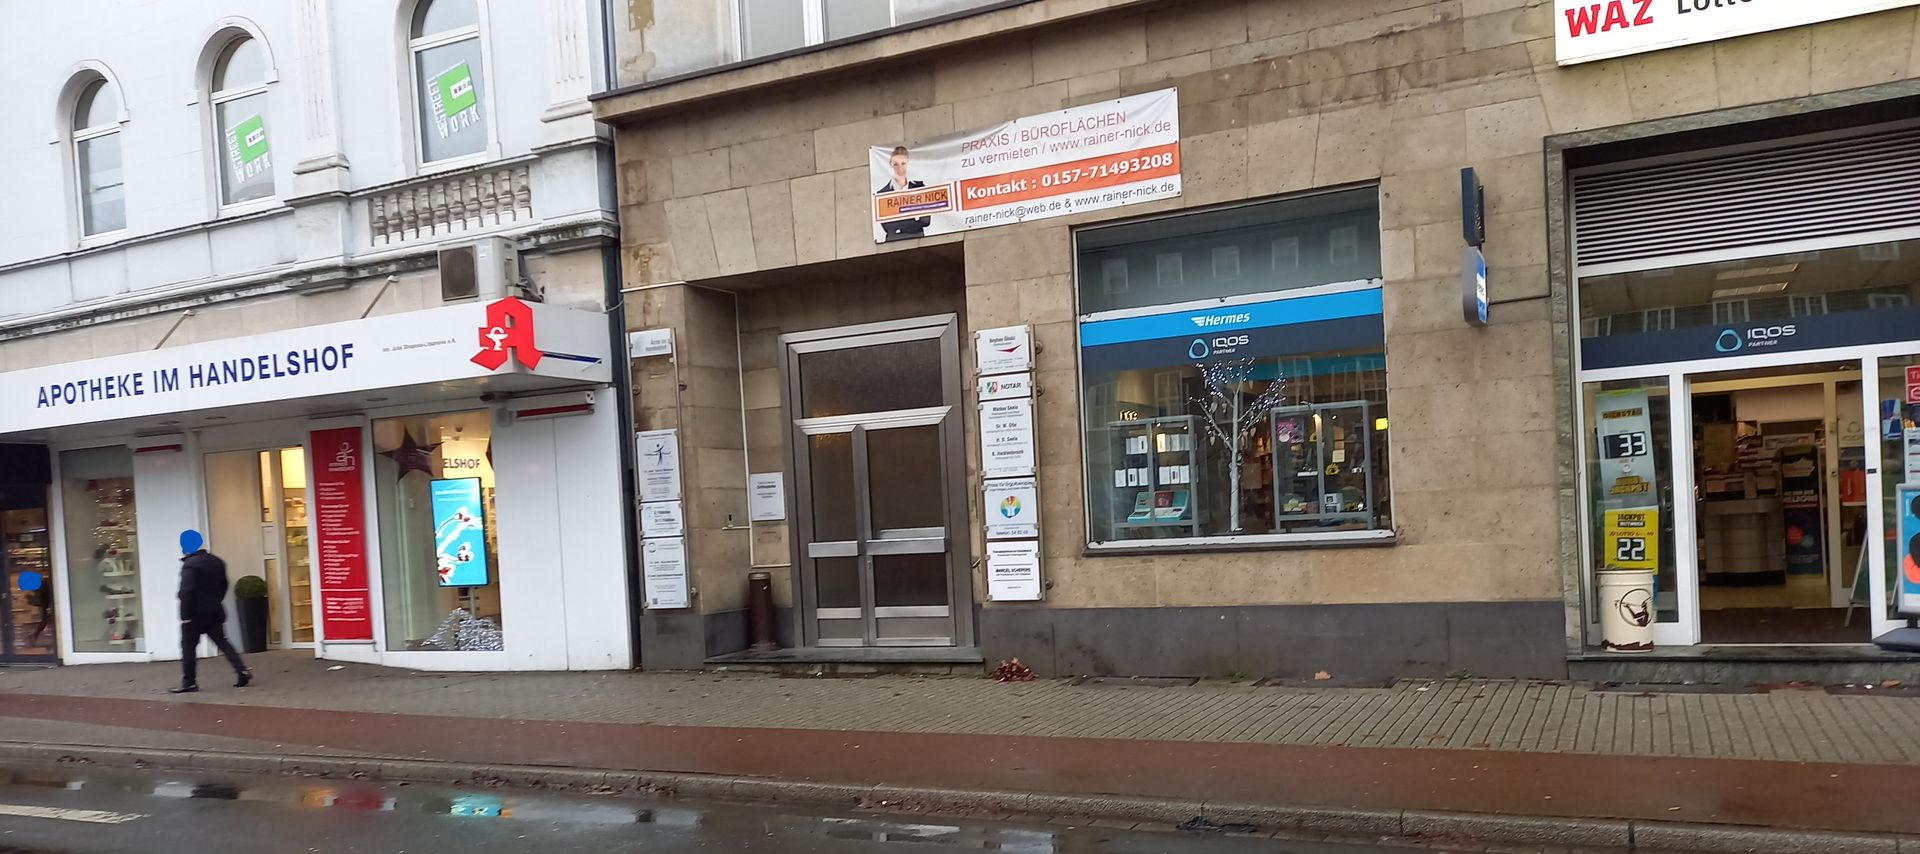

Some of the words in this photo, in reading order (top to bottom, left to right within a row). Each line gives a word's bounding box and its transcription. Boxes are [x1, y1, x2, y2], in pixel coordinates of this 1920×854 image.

[1565, 0, 1653, 37] WAZ
[437, 104, 480, 139] WORK
[961, 133, 1010, 153] PRAXIS
[1013, 132, 1018, 143] /
[1021, 111, 1126, 142] BÜROFLÄCHEN
[961, 158, 976, 168] zu
[980, 146, 1038, 164] vermieten
[1042, 142, 1046, 154] /
[1049, 120, 1171, 152] www.rainer-nick.de
[967, 178, 1027, 200] Kontakt
[1041, 152, 1173, 187] 0157-71493208
[887, 195, 922, 208] RAINER
[924, 190, 948, 203] NICK
[965, 201, 1061, 224] rainer-nick@web.de
[1064, 198, 1072, 208] &
[1074, 182, 1174, 206] www.rainer-nick.de
[1204, 312, 1250, 326] Hermes
[1747, 324, 1796, 339] IQOS
[1212, 335, 1249, 348] IQOS
[1747, 339, 1778, 347] PARTNER
[36, 372, 145, 409] APOTHEKE
[153, 367, 180, 393] IM
[189, 343, 354, 389] HANDELSHOF
[1000, 382, 1022, 390] NOTAR
[1618, 432, 1647, 457] 33
[1617, 538, 1645, 560] 22
